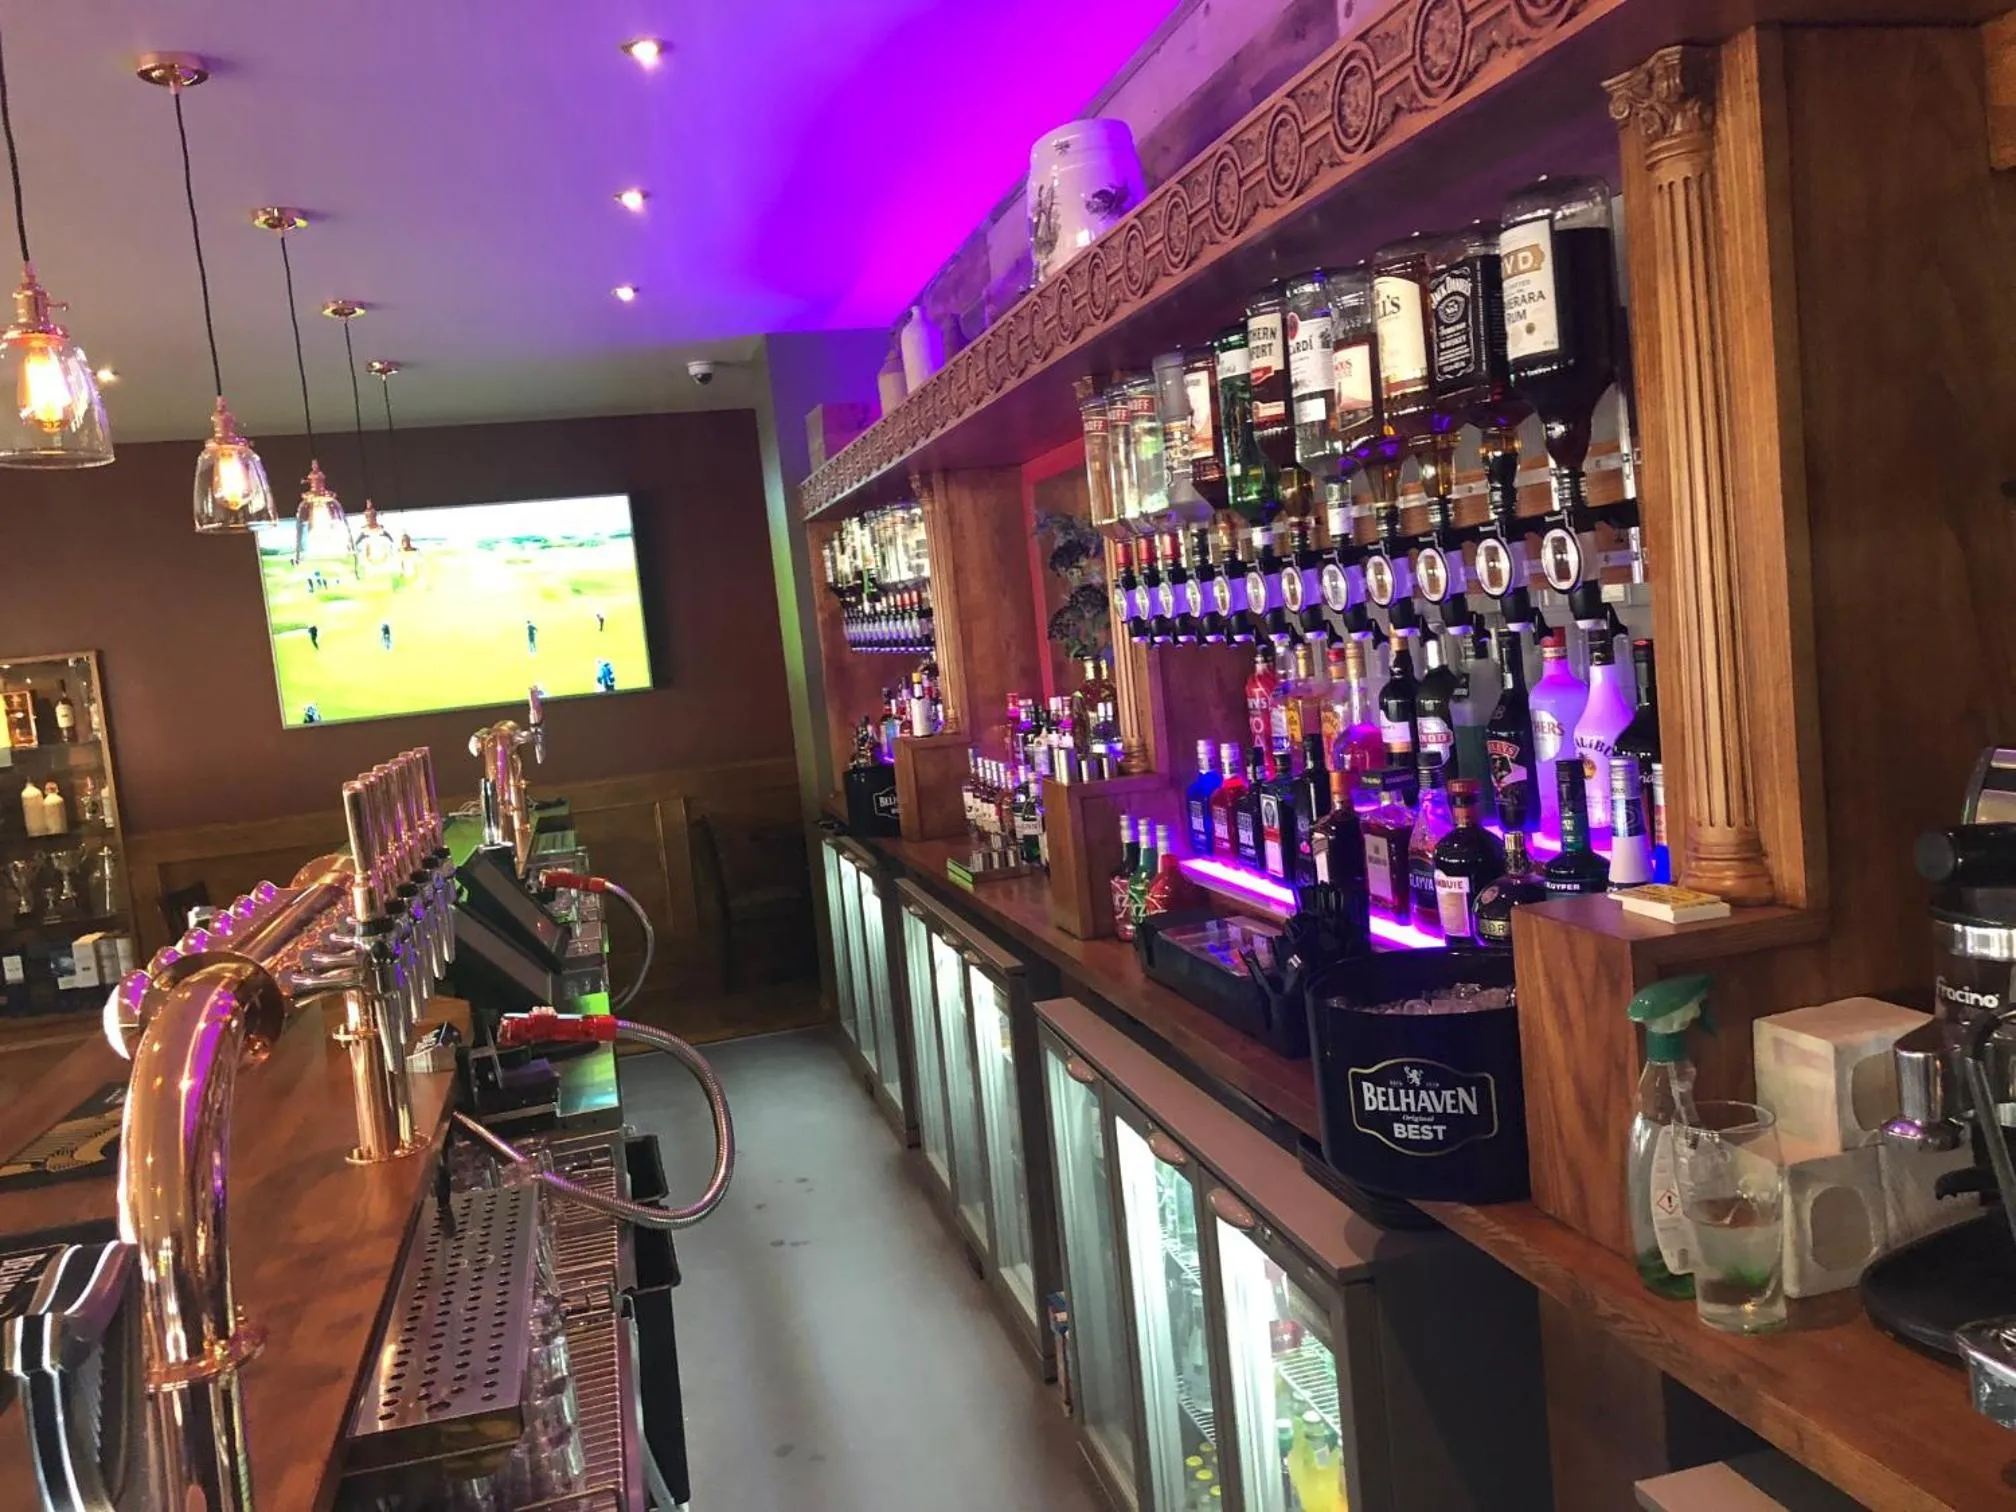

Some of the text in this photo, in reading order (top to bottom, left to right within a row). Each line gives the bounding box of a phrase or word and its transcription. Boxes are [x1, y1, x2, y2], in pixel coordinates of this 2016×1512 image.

[1937, 976, 1999, 1008] fracino
[1361, 1081, 1479, 1115] BELHAVEN
[1393, 1122, 1447, 1140] BEST
